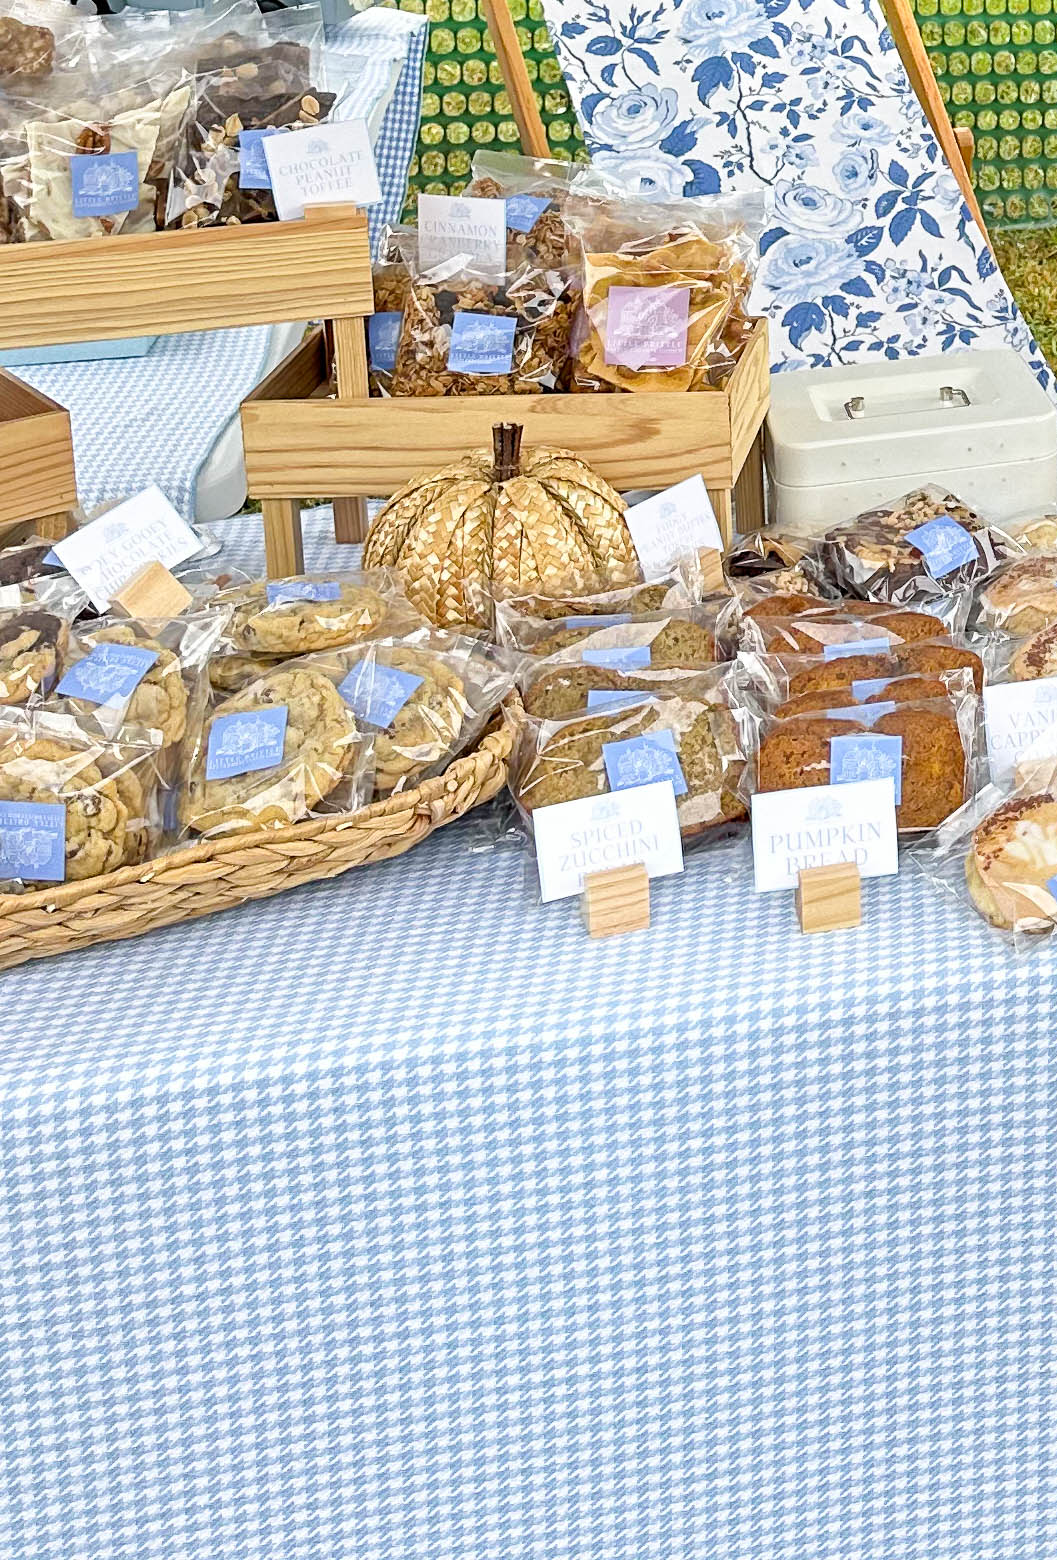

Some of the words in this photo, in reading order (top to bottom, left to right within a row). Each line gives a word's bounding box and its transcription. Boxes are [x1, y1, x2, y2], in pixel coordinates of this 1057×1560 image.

[279, 150, 363, 176] CHOCOLATE
[295, 166, 353, 185] PEANUT
[299, 177, 353, 197] TOFFEE
[423, 220, 498, 237] CINNAMON
[120, 517, 168, 552] GOOEY
[98, 529, 174, 582] HOCOLATE
[570, 819, 643, 849] SPICED
[768, 821, 882, 854] PUMPKIN
[559, 833, 660, 873] ZUCCHINI
